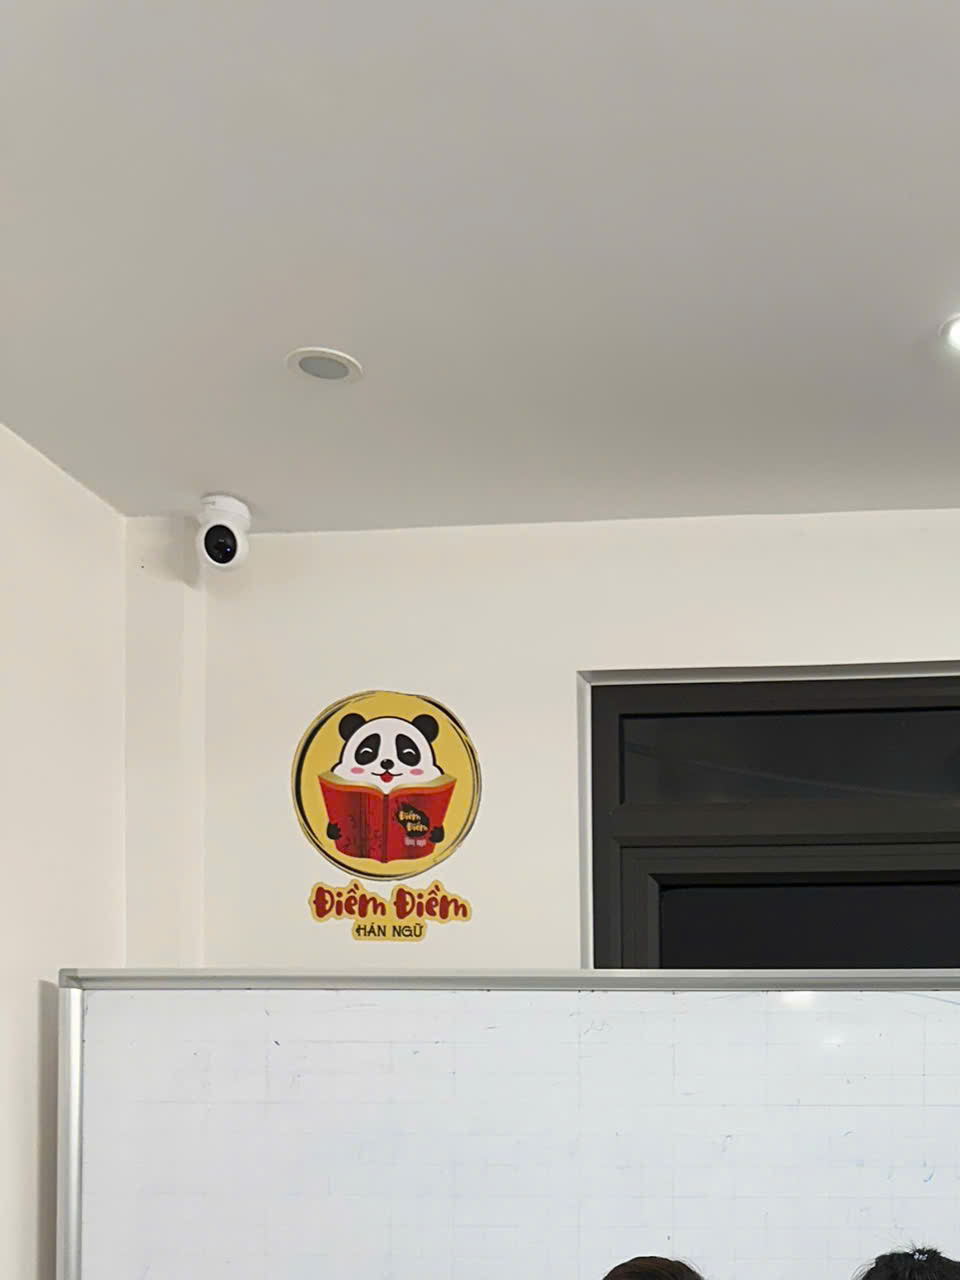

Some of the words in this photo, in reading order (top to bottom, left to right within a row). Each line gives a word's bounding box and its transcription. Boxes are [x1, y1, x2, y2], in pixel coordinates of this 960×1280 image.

[313, 883, 386, 918] Điềm
[393, 885, 468, 920] Điềm
[355, 921, 387, 937] HÁN
[392, 922, 424, 938] NGỮ
